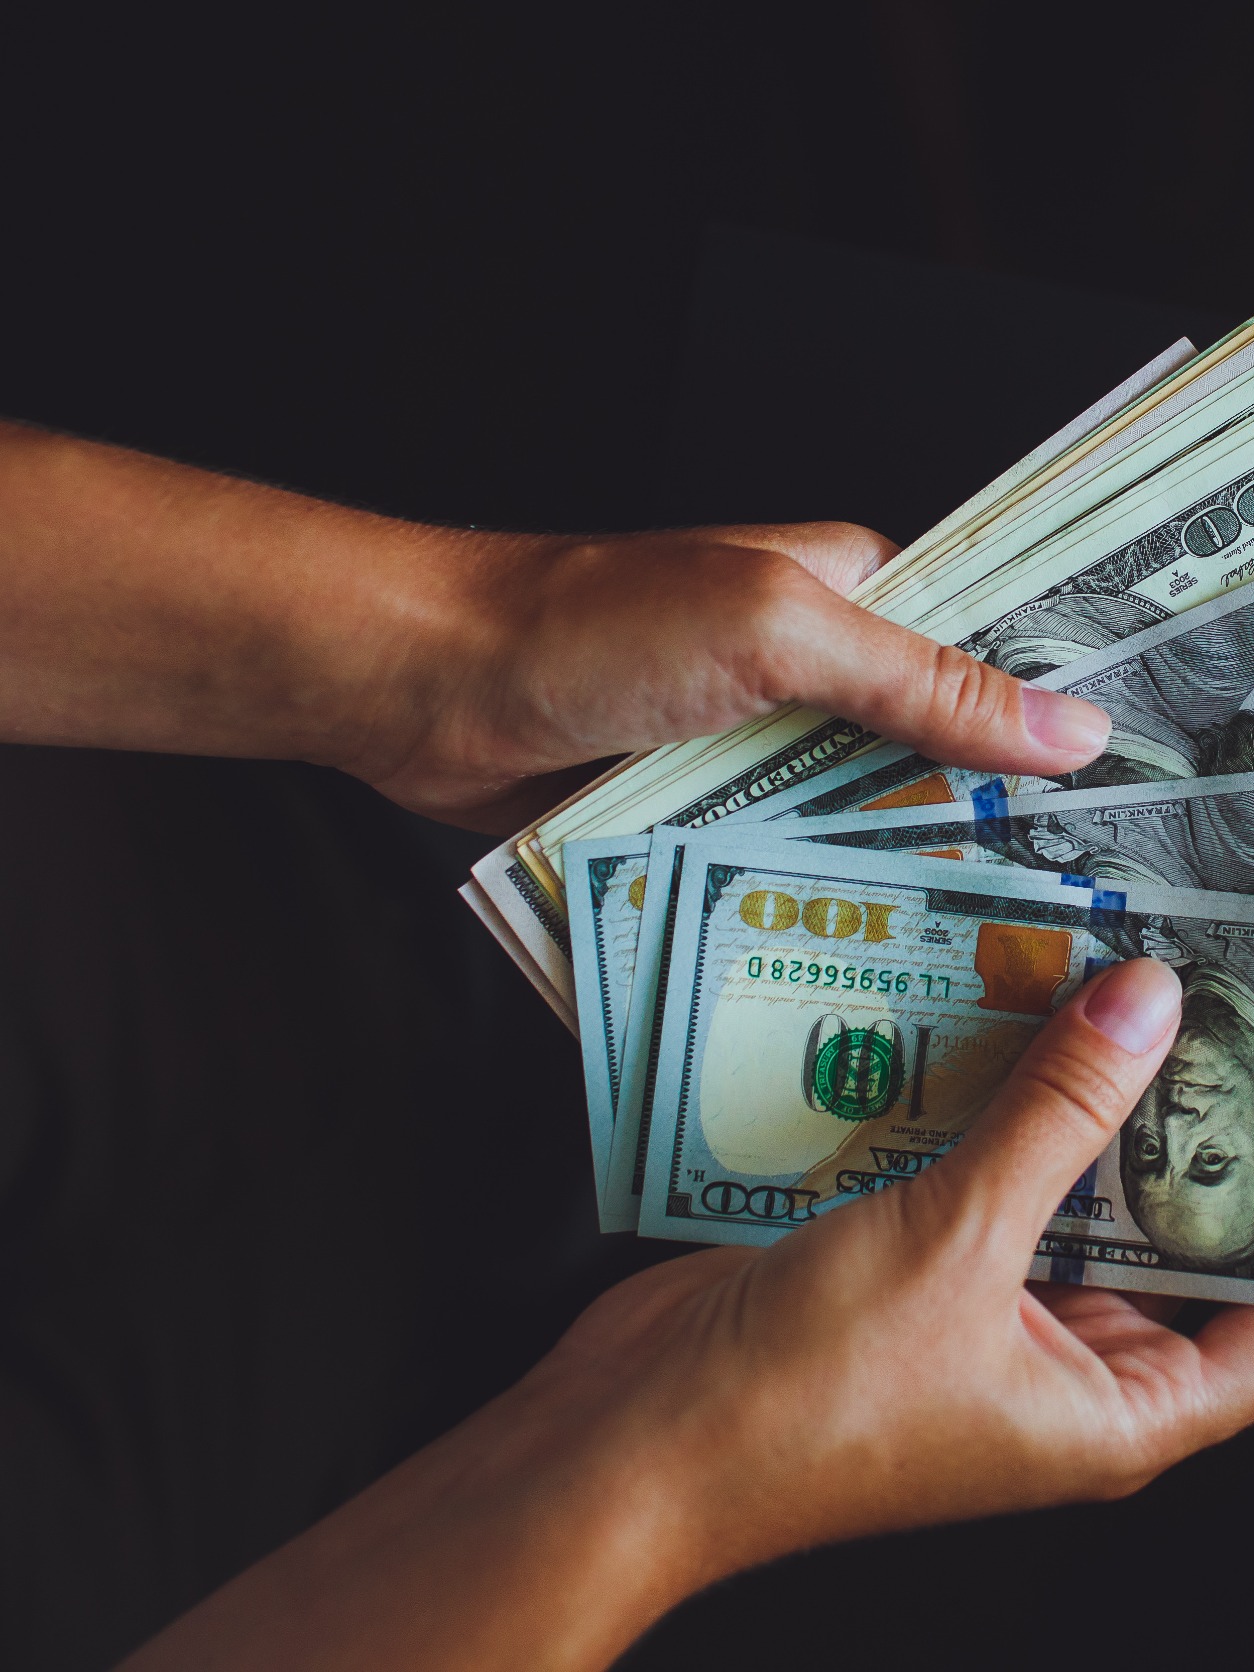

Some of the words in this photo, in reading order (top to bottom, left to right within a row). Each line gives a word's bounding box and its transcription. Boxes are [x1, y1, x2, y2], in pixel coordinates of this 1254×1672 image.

[1221, 546, 1242, 560] States.
[1168, 572, 1190, 589] 2003
[1171, 569, 1179, 577] A
[1168, 576, 1198, 598] SERIES
[993, 603, 1043, 635] FRANKLIN
[1070, 665, 1129, 697] FRANKLIN
[1108, 805, 1170, 820] FRANKLIN
[739, 890, 901, 943] 100
[919, 935, 952, 945] SERIES
[924, 928, 949, 937] 2009
[748, 956, 762, 978] D
[771, 959, 909, 994] 95956628
[918, 973, 951, 998] LL
[890, 1125, 927, 1137] PRIVATE
[928, 1128, 948, 1138] AND
[909, 1136, 946, 1145] TENDER
[701, 1181, 820, 1222] 100
